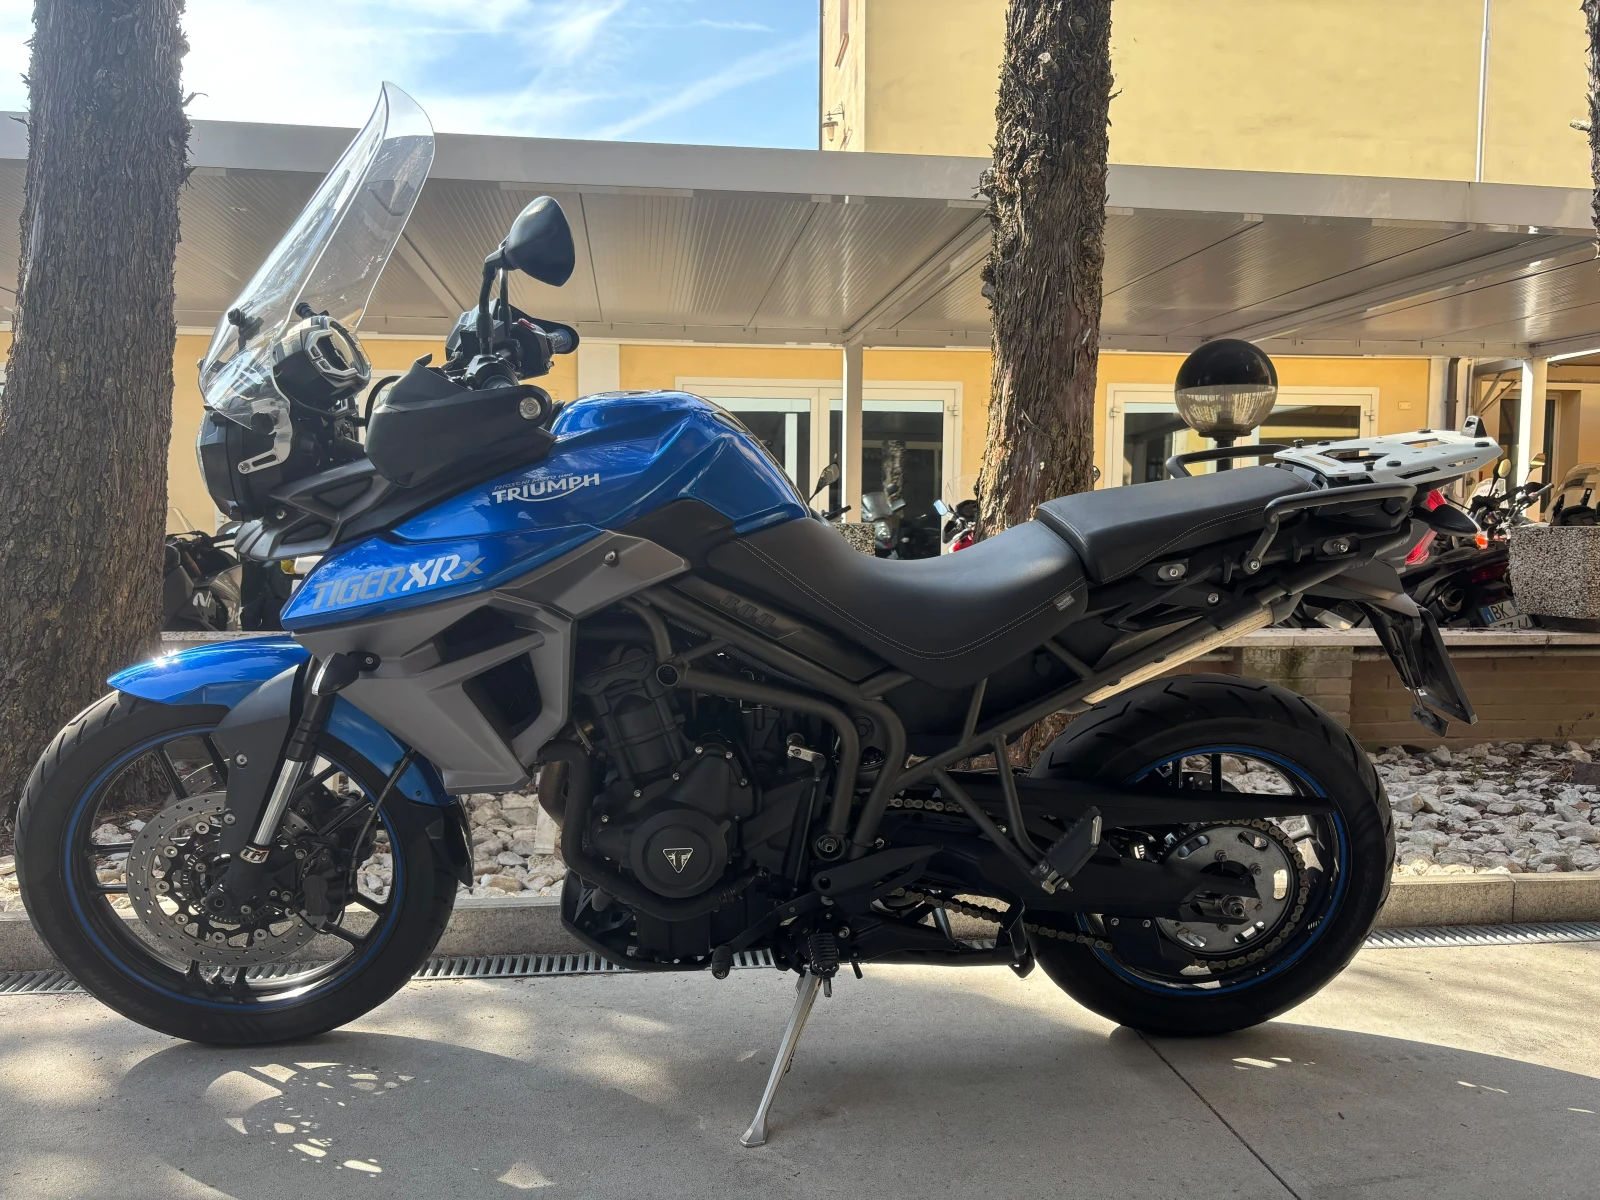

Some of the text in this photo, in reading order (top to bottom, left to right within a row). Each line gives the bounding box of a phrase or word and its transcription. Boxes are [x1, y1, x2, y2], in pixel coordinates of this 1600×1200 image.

[491, 473, 600, 504] TRIUMPH
[312, 566, 406, 610] TIGER
[1491, 603, 1510, 620] BK
